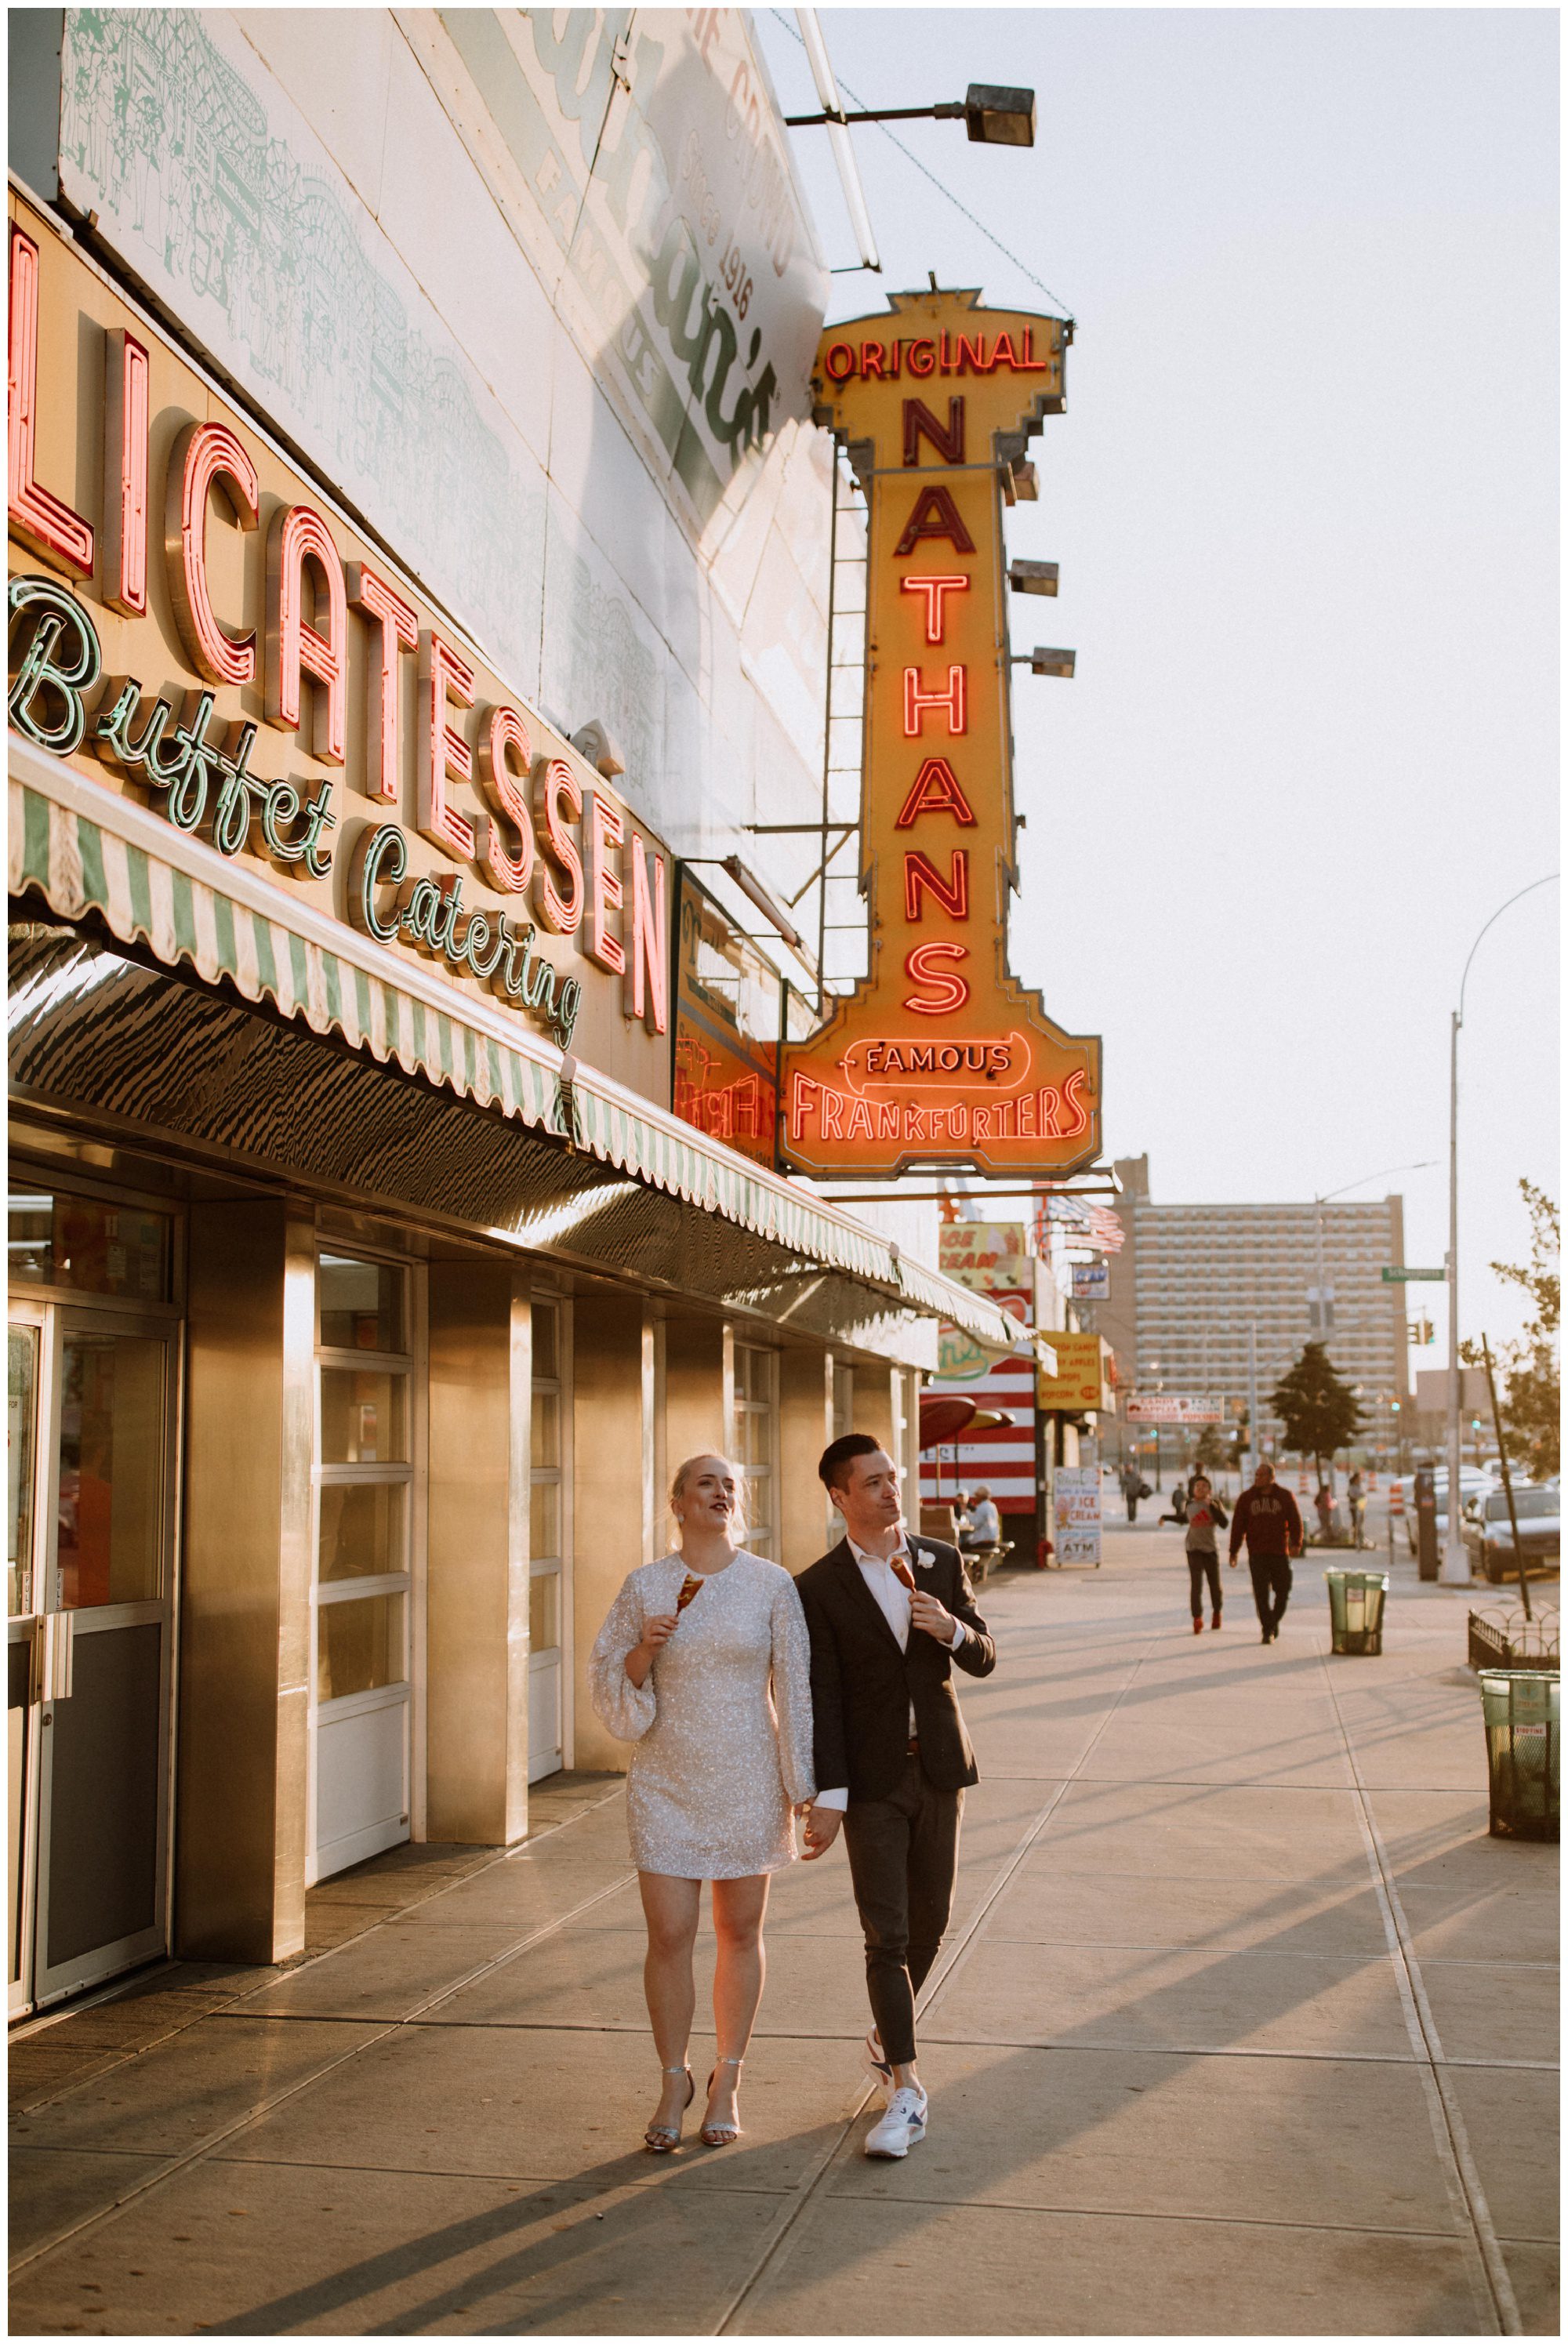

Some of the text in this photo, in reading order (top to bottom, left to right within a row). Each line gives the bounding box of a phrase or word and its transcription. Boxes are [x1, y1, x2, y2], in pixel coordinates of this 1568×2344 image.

[535, 147, 661, 395] FAMOUS
[719, 227, 753, 321] 1916
[826, 324, 1047, 382] ORIGINAL
[8, 225, 666, 1036] LICATESSEN
[893, 395, 978, 1016] NATHANS
[8, 573, 582, 1051] Buffet Catering
[866, 1043, 1013, 1074] FAMOUS
[793, 1069, 1087, 1141] FRANKFURTERS
[1070, 1510, 1101, 1521] CREAM
[1079, 1497, 1095, 1508] ICE
[1250, 1497, 1283, 1515] GAP
[1063, 1543, 1094, 1552] ATM
